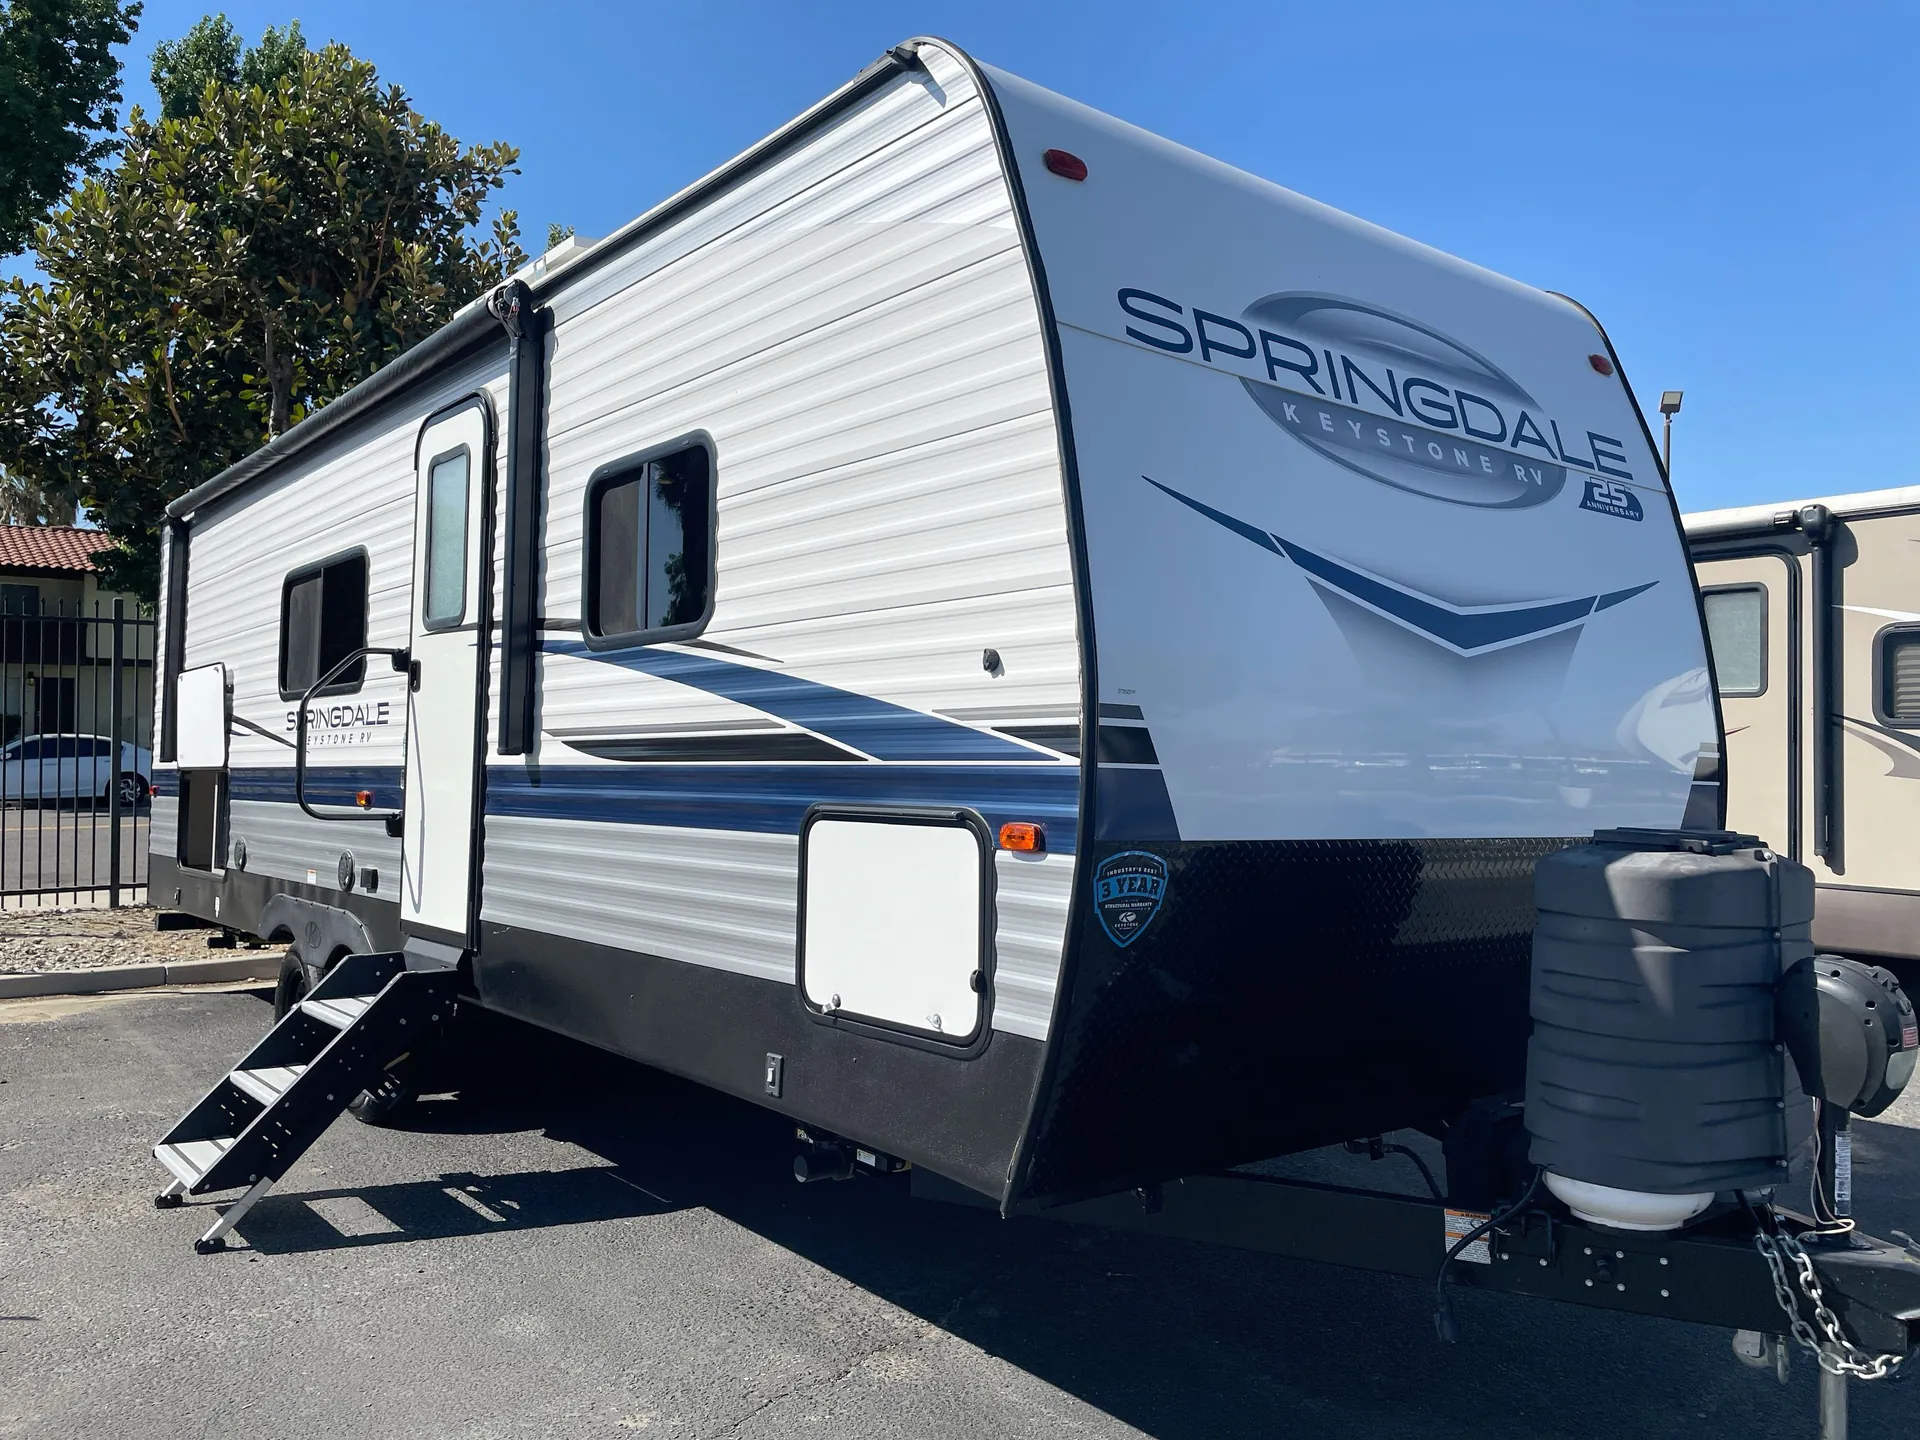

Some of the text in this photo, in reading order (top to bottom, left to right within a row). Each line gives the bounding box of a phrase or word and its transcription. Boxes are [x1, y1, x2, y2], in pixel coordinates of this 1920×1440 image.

[1117, 287, 1633, 480] SPRINGDALE
[1282, 402, 1543, 486] KEYSTONE RV
[1586, 500, 1640, 519] ANNIVERSARY
[286, 702, 389, 731] SRINGDALE
[306, 732, 372, 746] EYSTONE RV
[1102, 876, 1160, 899] 3 YEAR
